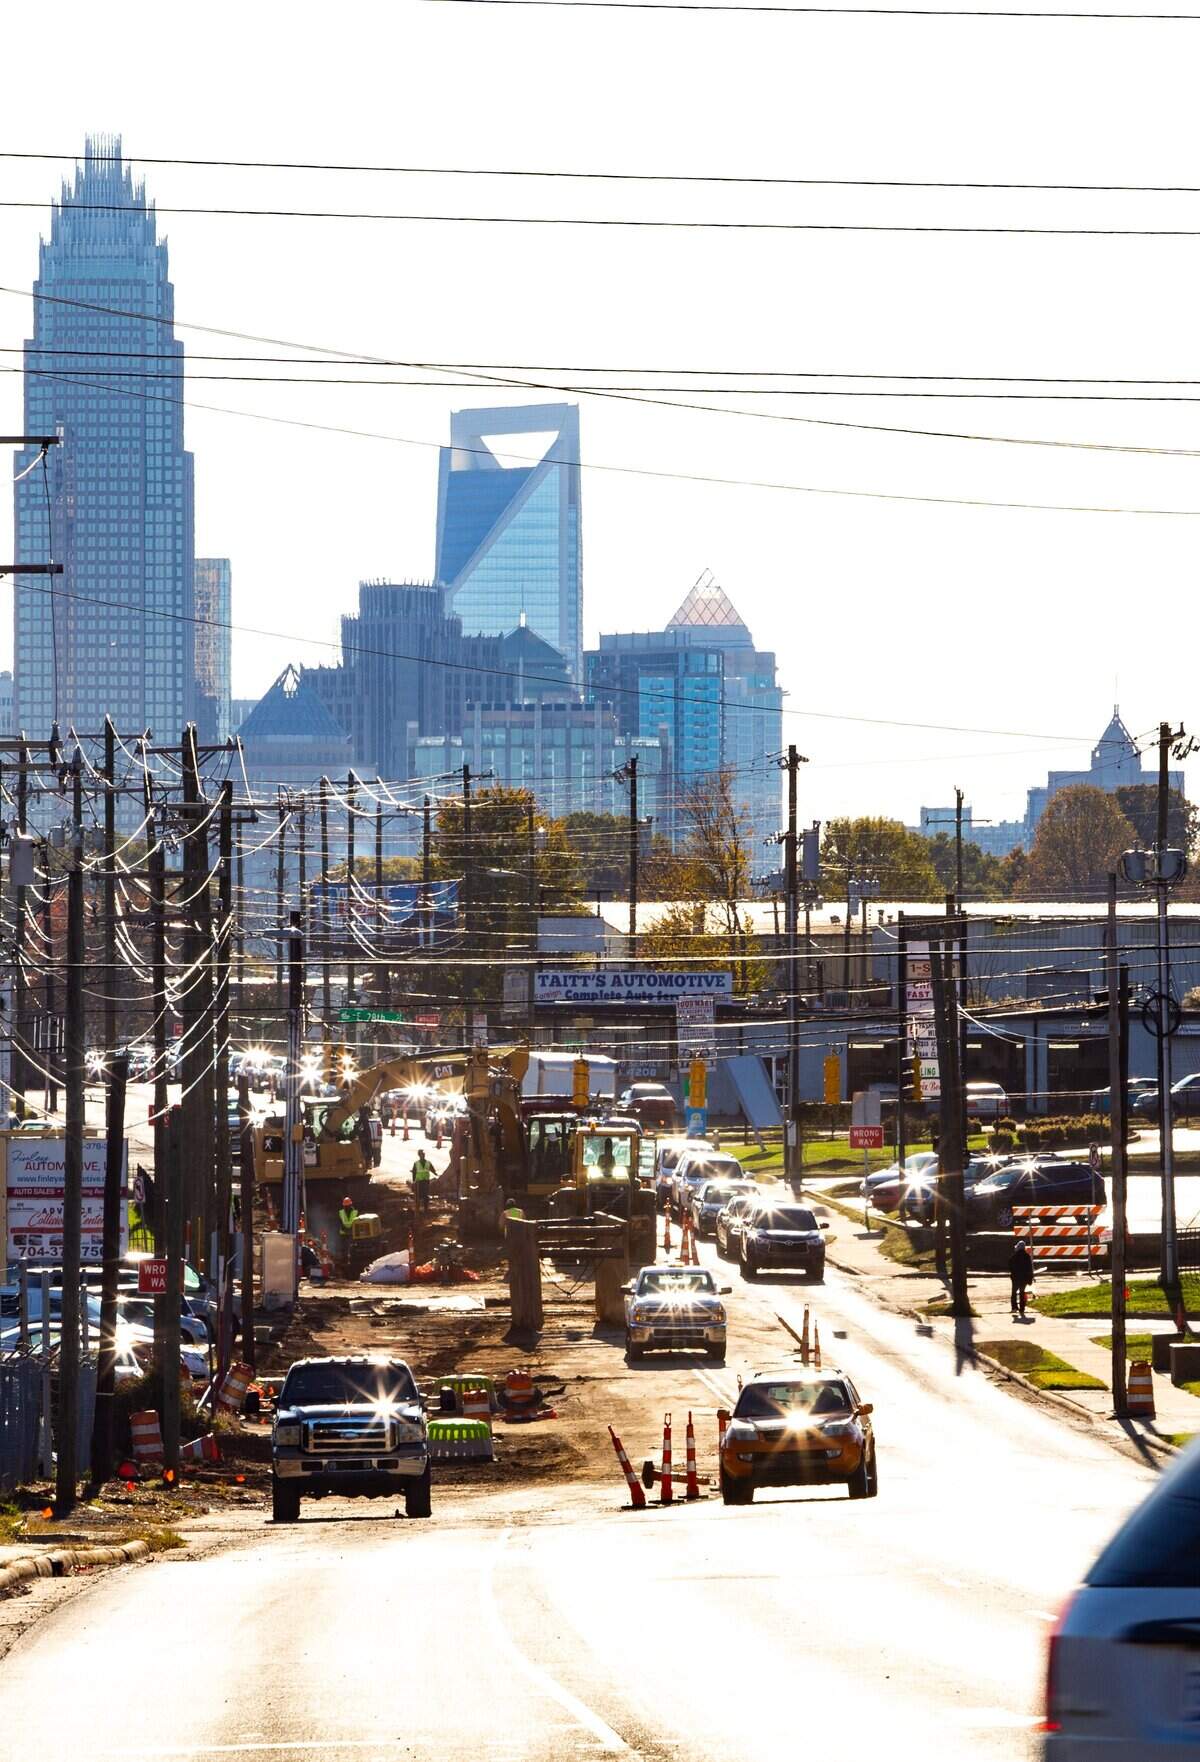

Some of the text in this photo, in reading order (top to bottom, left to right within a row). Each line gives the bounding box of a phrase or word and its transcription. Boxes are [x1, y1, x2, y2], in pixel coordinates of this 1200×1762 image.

[538, 974, 726, 988] TAITT'S AUTOMOTIVE
[565, 989, 622, 1001] Complete
[435, 1065, 453, 1078] CAT
[14, 1187, 55, 1195] AUTO SALES
[144, 1265, 166, 1274] WRO
[151, 1278, 167, 1288] WA
